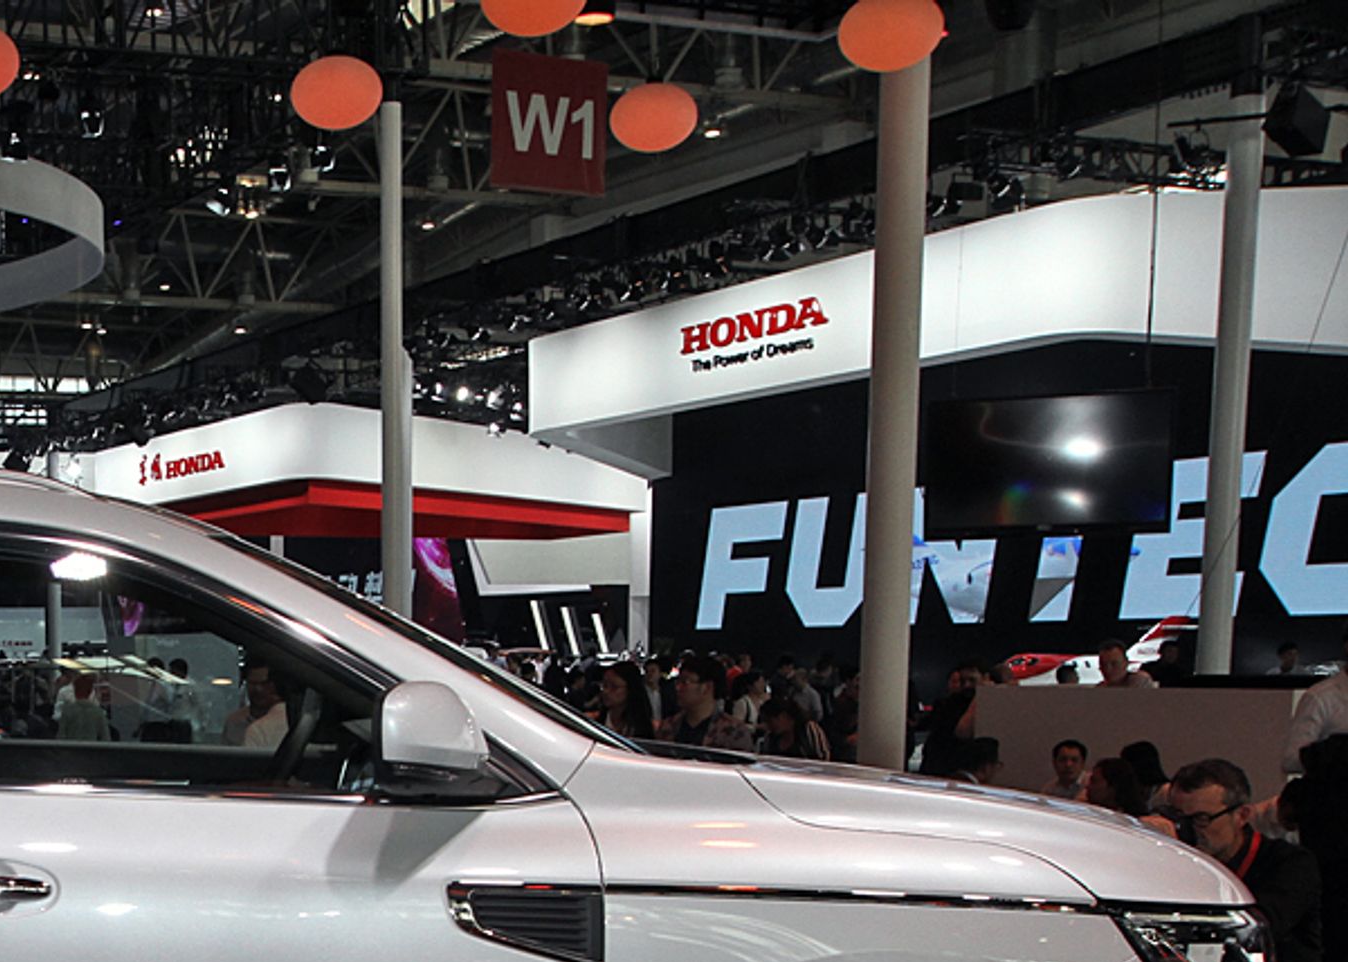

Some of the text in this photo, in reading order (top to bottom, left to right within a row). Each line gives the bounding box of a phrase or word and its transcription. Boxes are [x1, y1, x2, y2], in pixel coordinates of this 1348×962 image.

[506, 90, 594, 160] W1
[681, 297, 829, 355] HONDA
[692, 338, 814, 372] The Power of Dreams
[165, 450, 226, 479] HONDA
